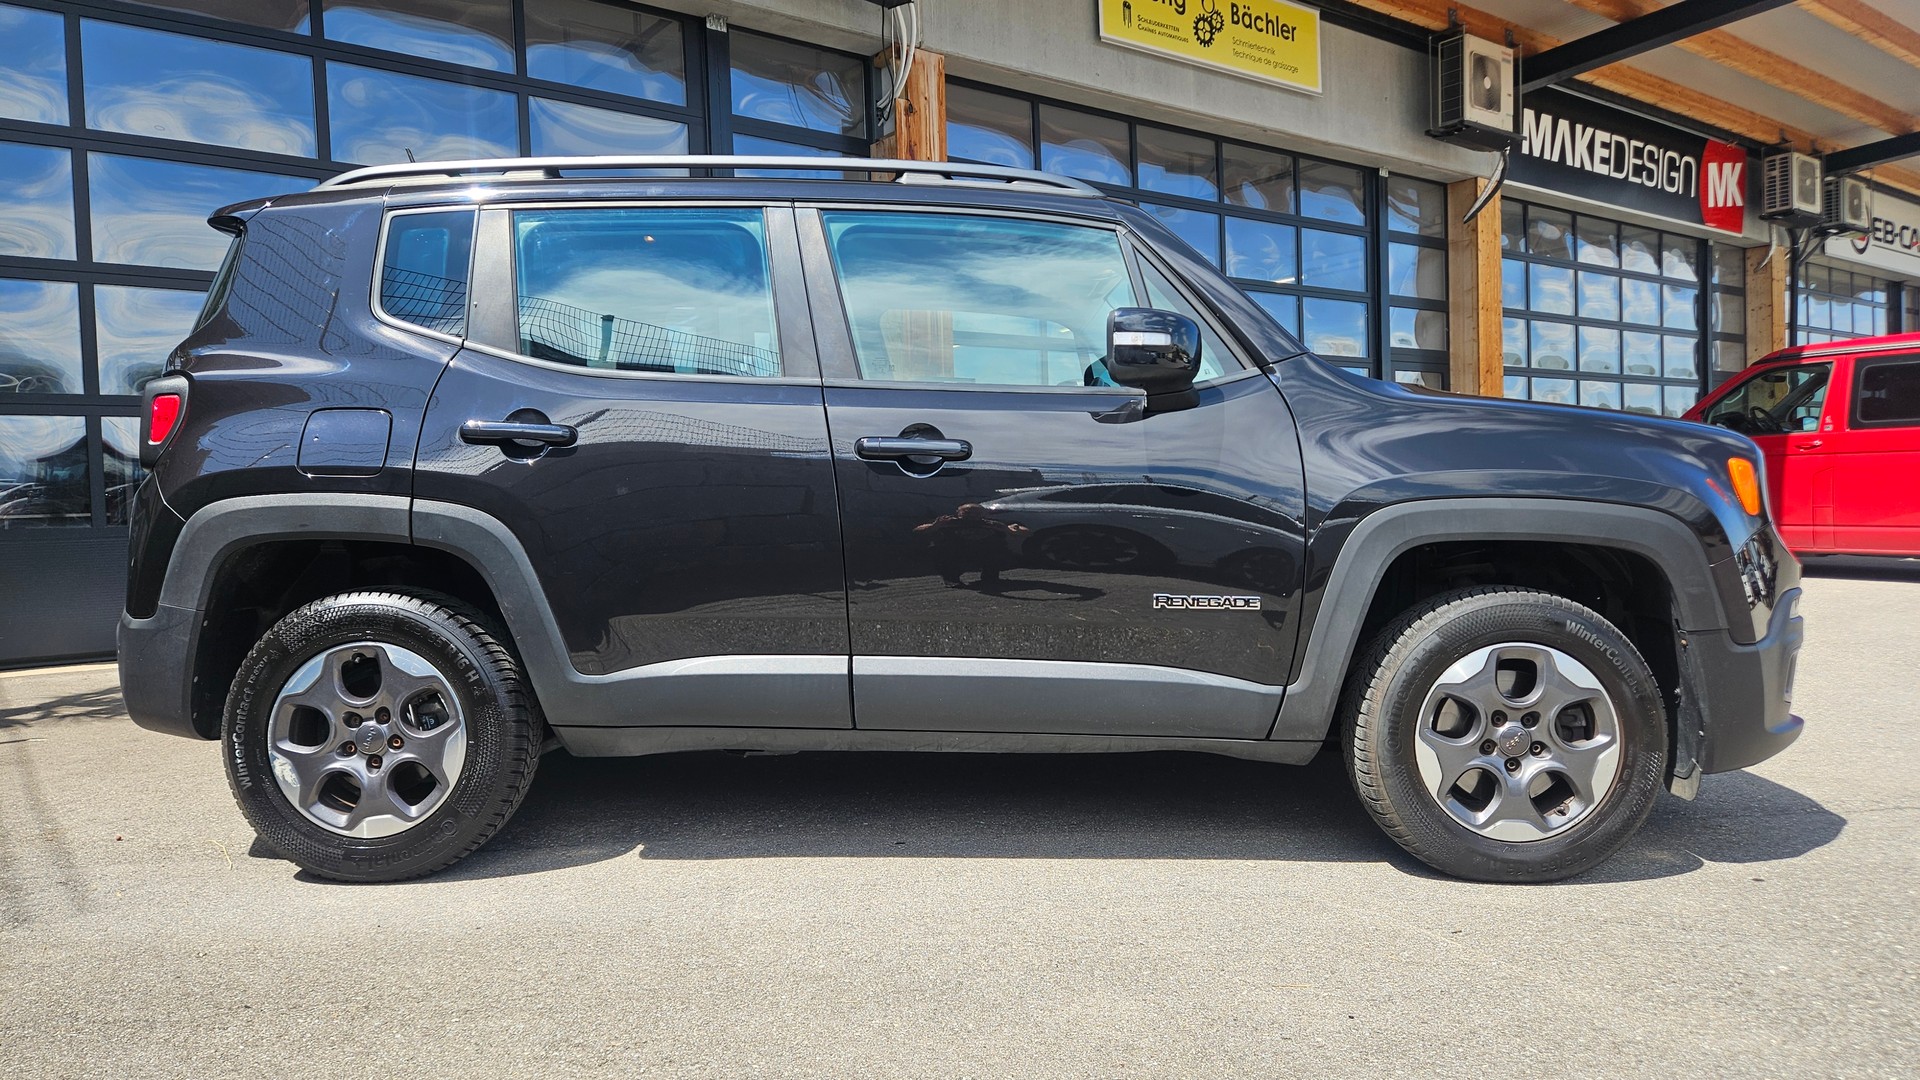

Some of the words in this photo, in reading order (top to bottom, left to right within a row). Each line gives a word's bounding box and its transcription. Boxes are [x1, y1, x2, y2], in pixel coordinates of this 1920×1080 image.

[1231, 2, 1297, 42] Bächler
[1707, 161, 1744, 208] MK
[1153, 593, 1261, 610] RENEGADE
[232, 687, 255, 791] WinterContact
